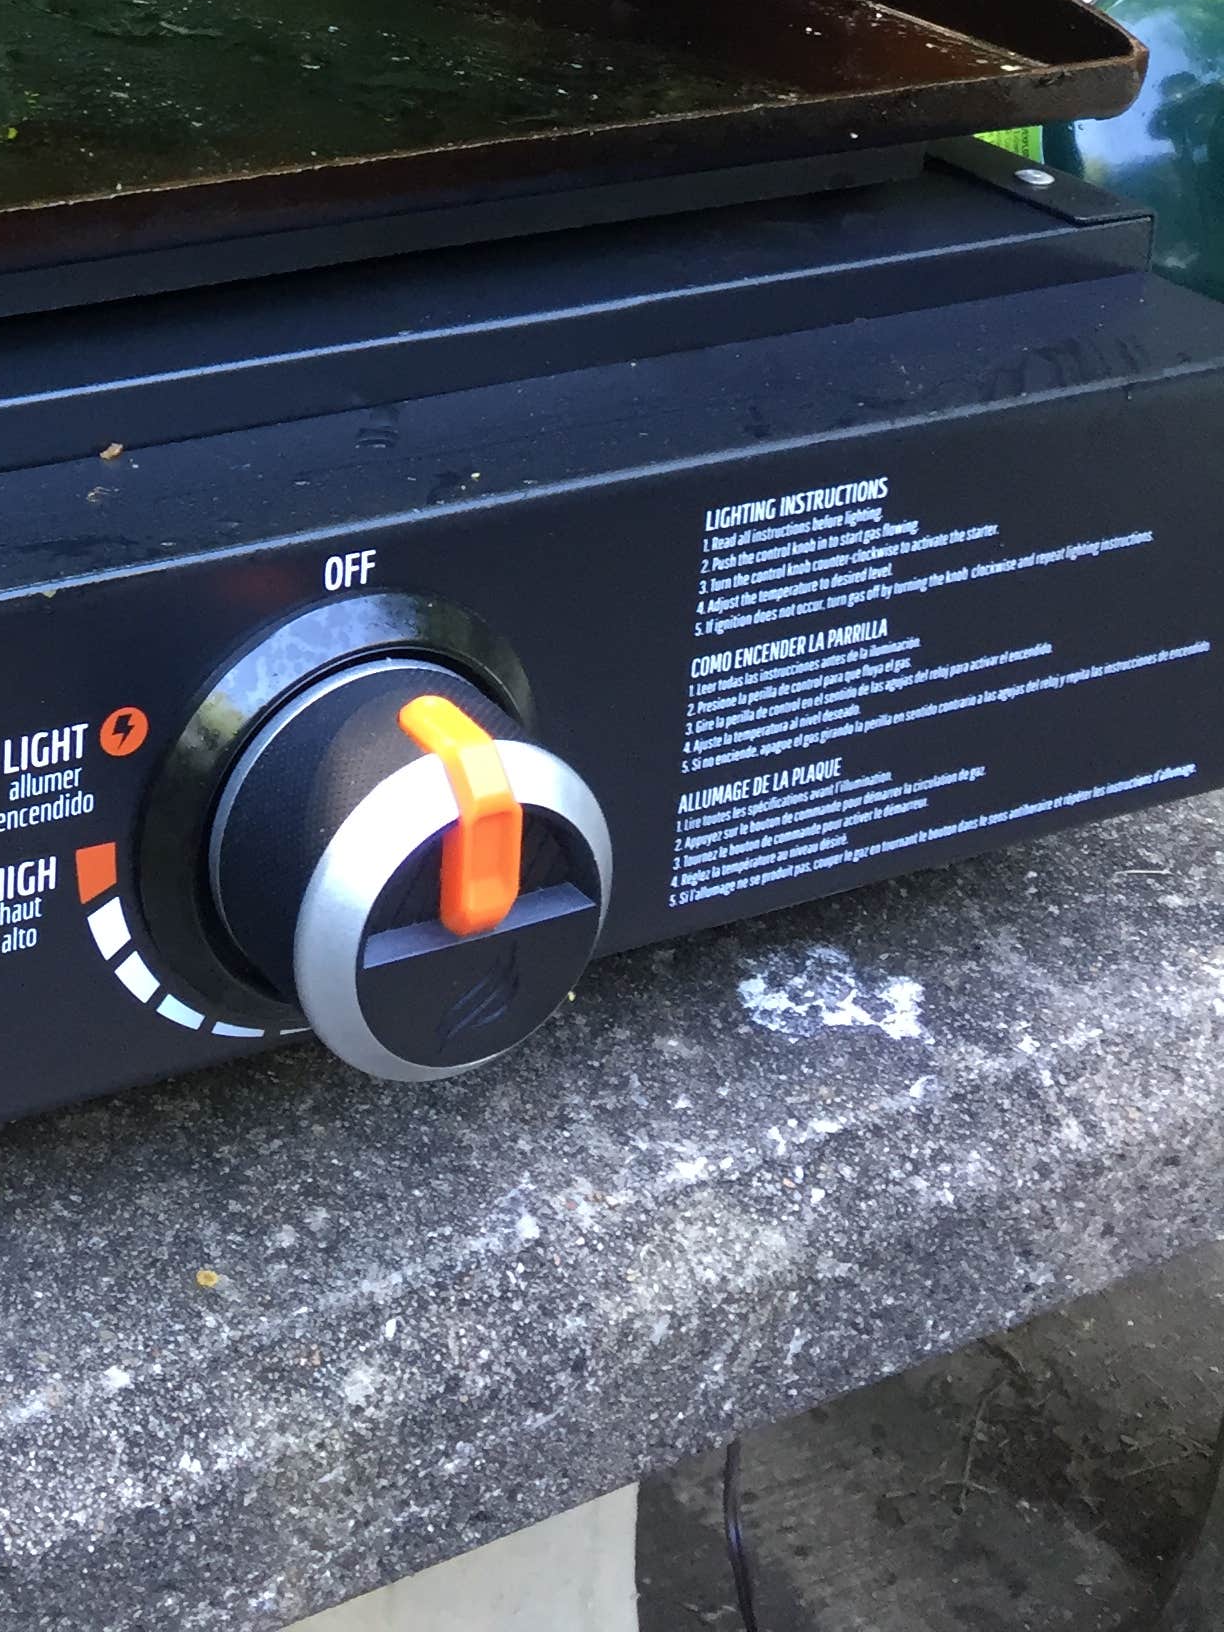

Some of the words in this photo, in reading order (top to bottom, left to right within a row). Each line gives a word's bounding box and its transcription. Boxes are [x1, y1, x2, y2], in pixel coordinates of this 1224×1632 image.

[706, 499, 776, 531] LIGHTING
[780, 477, 888, 516] INSTRUCTIONS
[712, 533, 736, 550] Read
[752, 522, 810, 542] instructions
[324, 549, 376, 591] OFF
[712, 554, 736, 571] Push
[738, 552, 754, 566] the
[756, 543, 791, 562] control
[733, 573, 749, 587] the
[741, 592, 757, 606] the
[691, 651, 732, 678] COMO
[734, 636, 805, 668] ENCENDER
[808, 632, 824, 652] LA
[827, 618, 887, 648] PARRILLA
[4, 723, 88, 774] LIGHT
[9, 768, 82, 801] allumer
[678, 779, 750, 814] ALLUMAGE
[752, 775, 770, 796] DE
[773, 771, 788, 791] LA
[792, 757, 842, 786] PLAQUE
[0, 897, 42, 925] haut
[1, 927, 37, 954] alto
